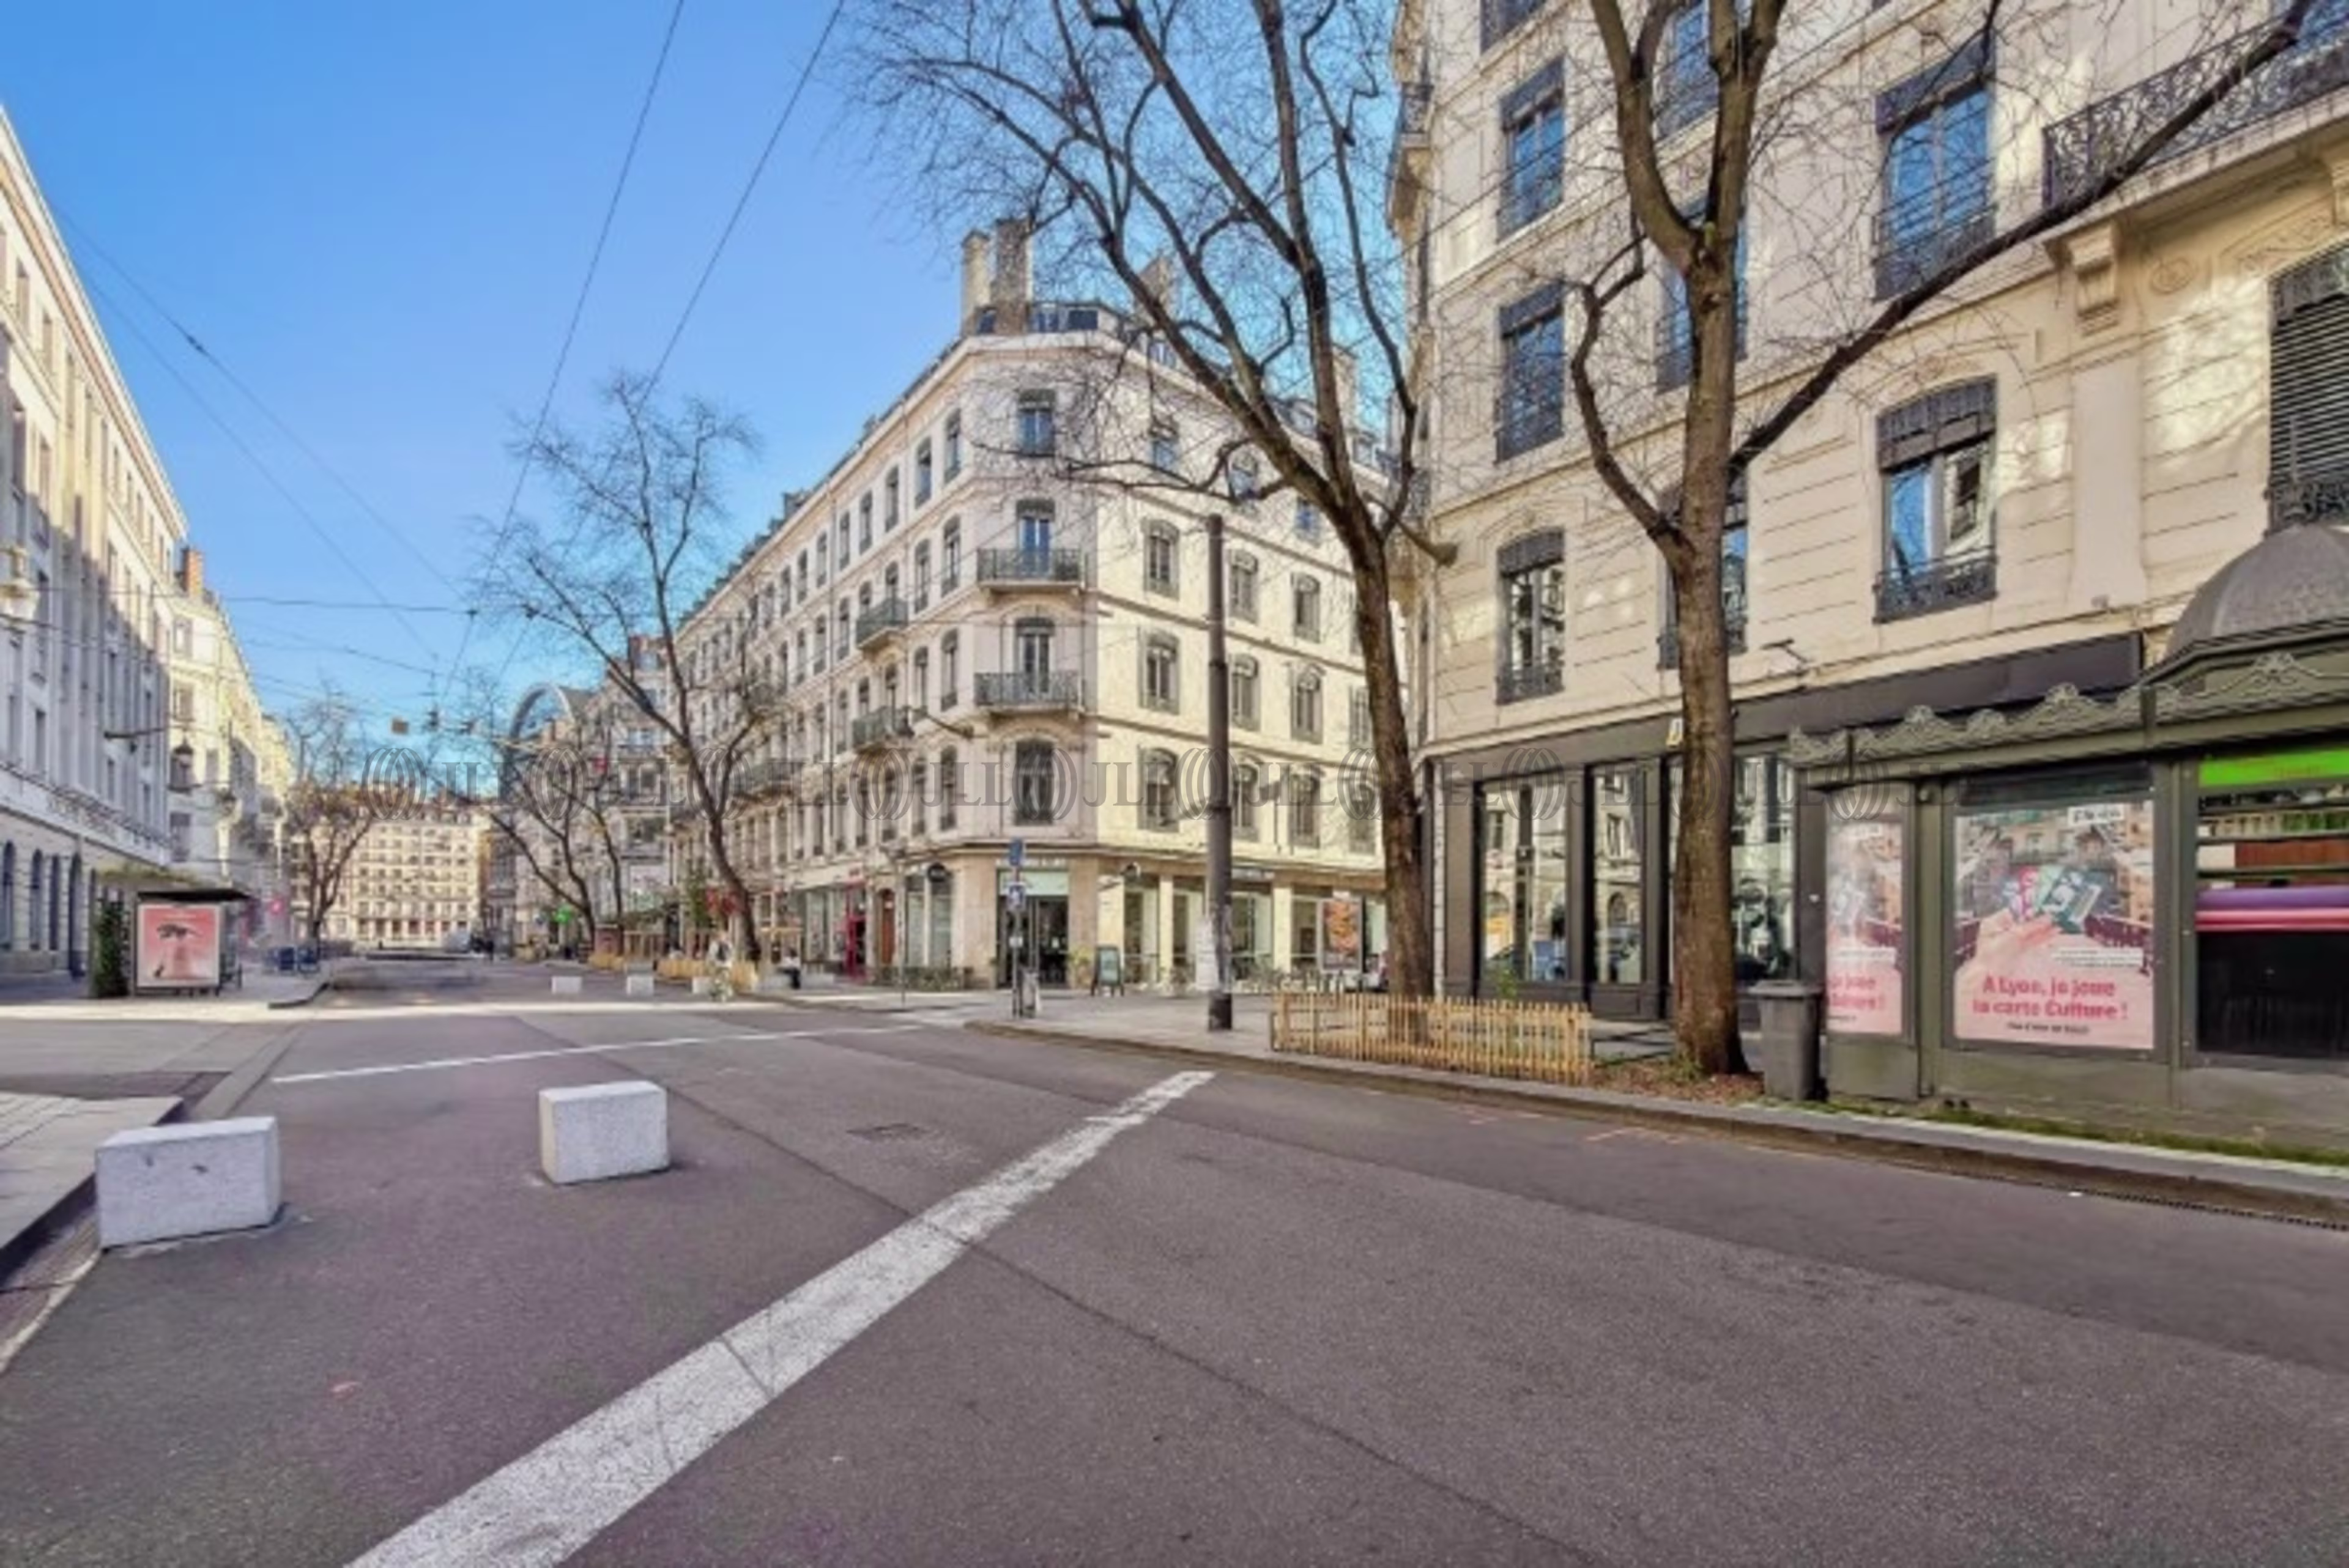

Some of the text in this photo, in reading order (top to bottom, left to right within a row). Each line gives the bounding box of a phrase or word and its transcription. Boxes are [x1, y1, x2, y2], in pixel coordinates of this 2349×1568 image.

[2071, 979, 2115, 997] joue
[1972, 999, 1990, 1014] la
[1992, 1001, 2041, 1016] carte
[2045, 999, 2118, 1019] Culture
